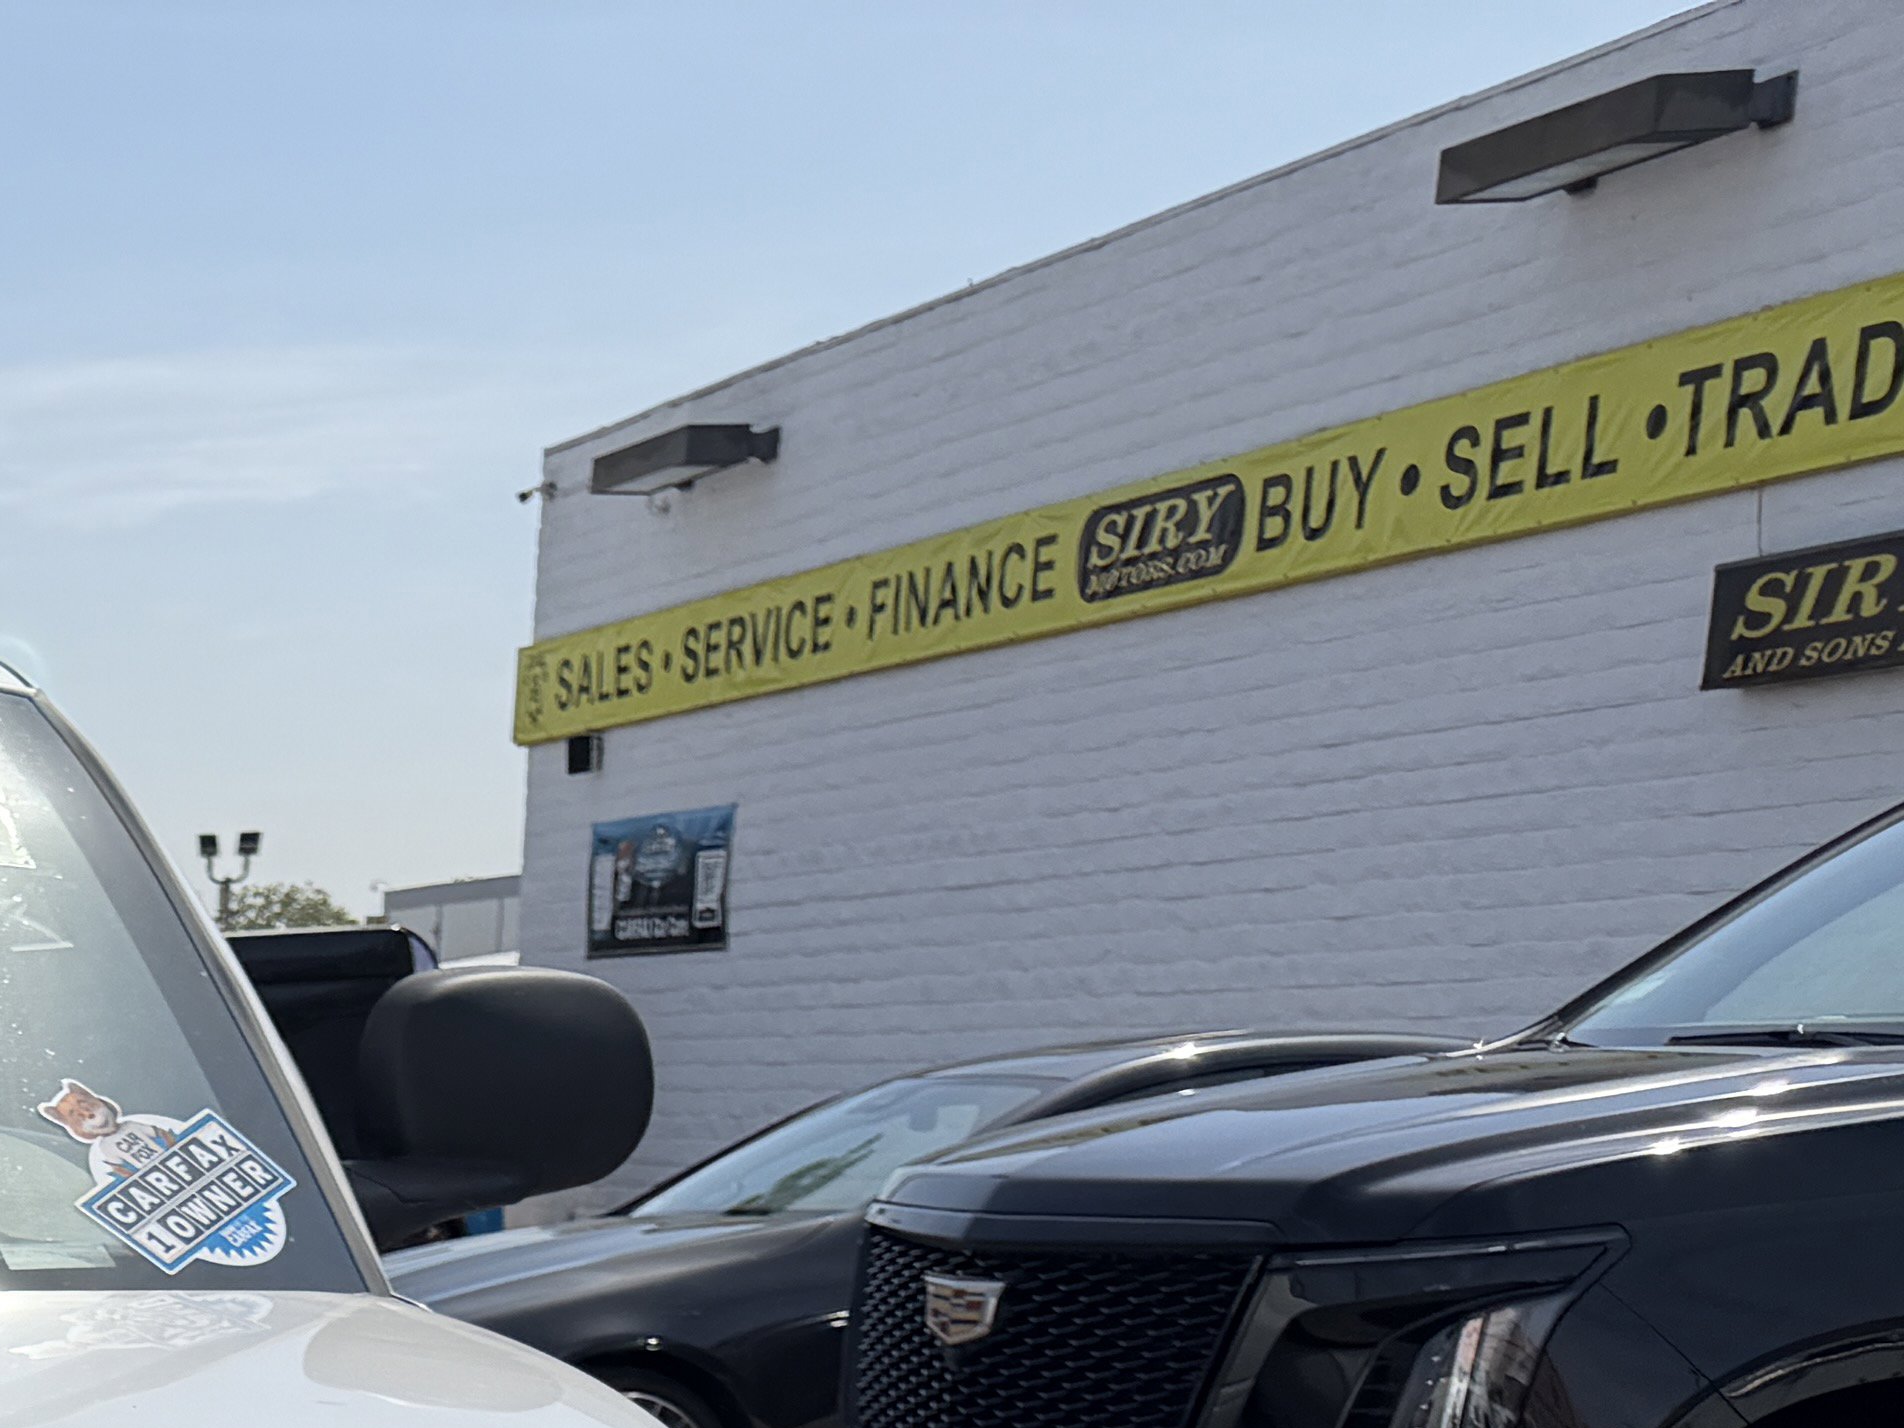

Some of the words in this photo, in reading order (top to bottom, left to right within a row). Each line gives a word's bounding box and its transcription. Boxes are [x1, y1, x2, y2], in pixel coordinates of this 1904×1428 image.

[1255, 446, 1389, 554] BUY
[1439, 394, 1620, 511] SELL
[1677, 319, 1904, 457] TRAD
[1086, 483, 1237, 570] SIRY
[554, 639, 654, 712] SALES
[680, 592, 835, 684] SERVICE
[867, 533, 1060, 641] FINANCE
[1730, 552, 1904, 641] SIR
[1722, 646, 1795, 680] AND
[1798, 630, 1897, 667] SONS
[106, 1133, 242, 1226] CARFAX
[115, 1131, 143, 1153] CAR
[130, 1142, 160, 1165] FOX
[166, 1158, 274, 1240] OWNER
